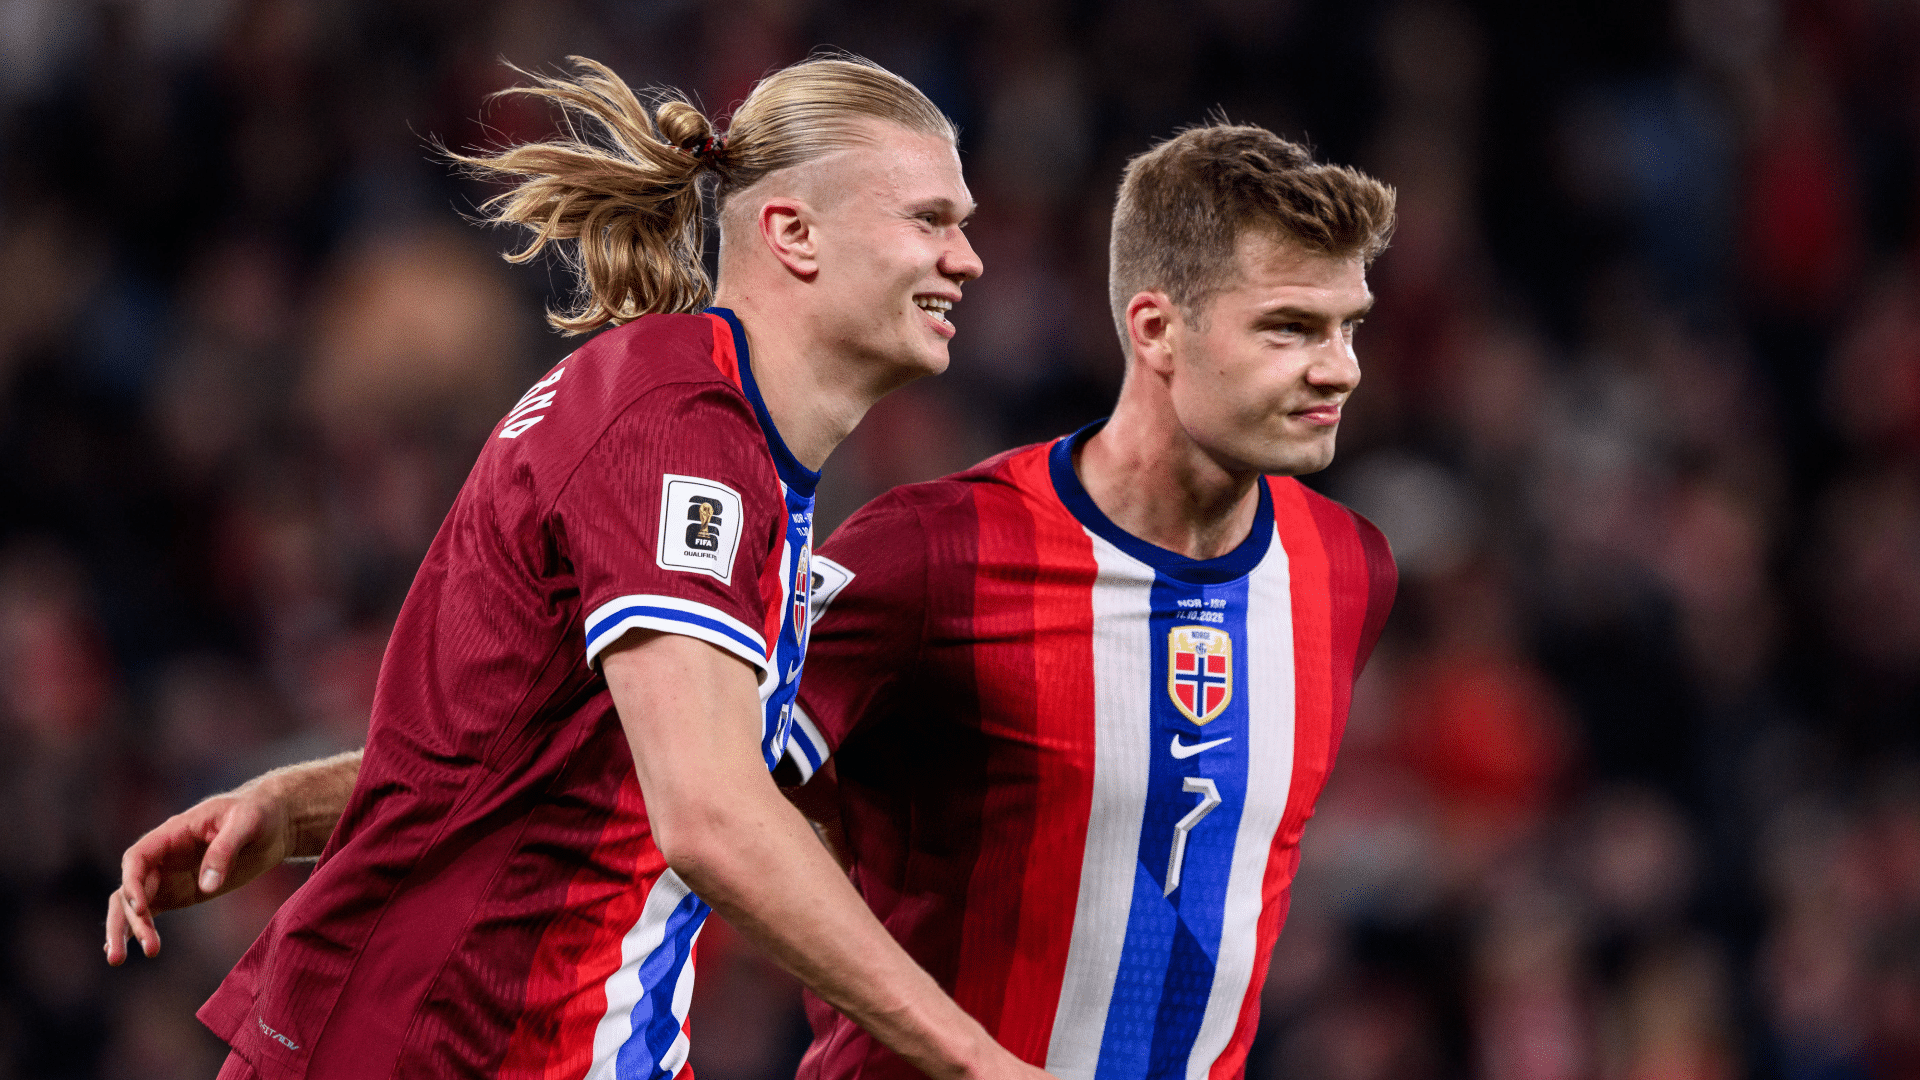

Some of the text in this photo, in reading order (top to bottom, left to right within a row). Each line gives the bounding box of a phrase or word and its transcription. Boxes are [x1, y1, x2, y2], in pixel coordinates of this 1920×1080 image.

[695, 538, 712, 547] FIFA
[1177, 598, 1202, 608] NOR
[1162, 776, 1223, 900] 7
